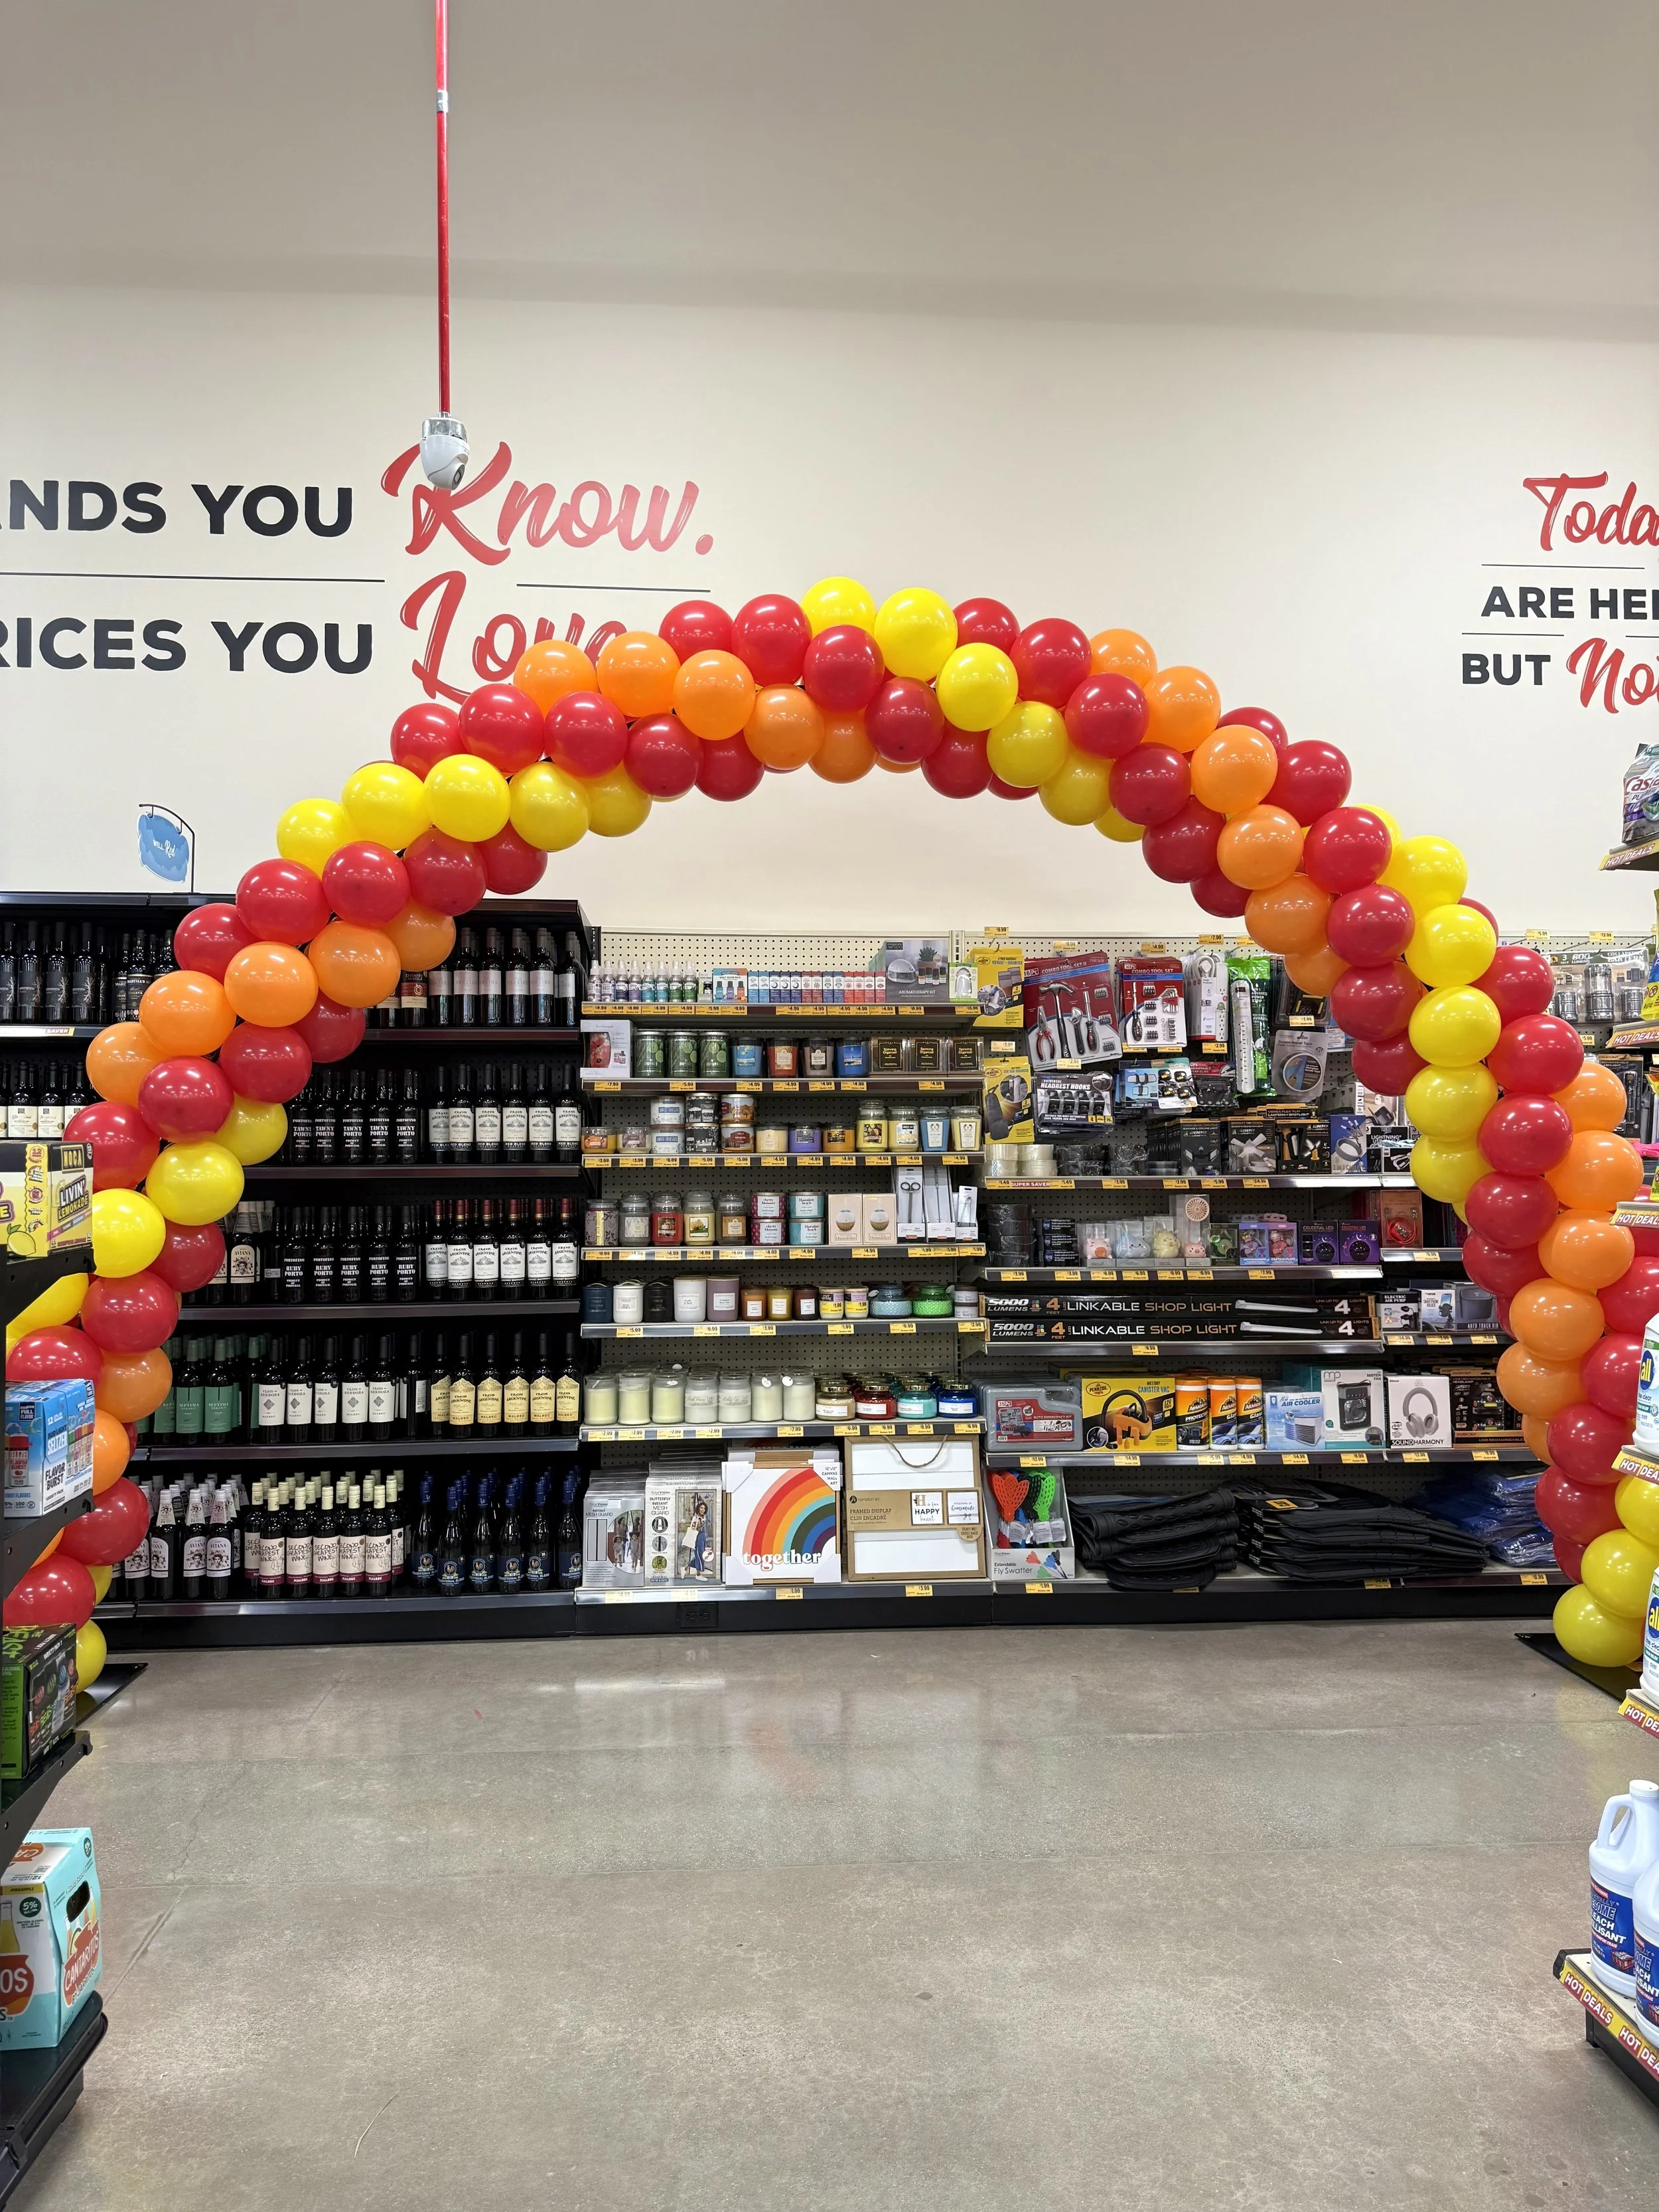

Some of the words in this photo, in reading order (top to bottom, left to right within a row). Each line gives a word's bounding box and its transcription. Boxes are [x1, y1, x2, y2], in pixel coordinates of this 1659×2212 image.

[0, 479, 166, 536] NDS
[191, 483, 354, 538] YOU
[382, 441, 713, 565] Know.
[1481, 586, 1575, 619] ARE
[212, 621, 372, 675] YOU
[1462, 653, 1551, 686] BUT
[1566, 637, 1659, 714] No
[153, 839, 164, 851] WELL
[1605, 855, 1624, 867] HOT
[1624, 844, 1656, 860] DEALS
[1615, 1035, 1630, 1044] HOT
[60, 1179, 85, 1207] LIVIN'
[58, 1194, 89, 1220] LEMONADE
[1617, 1213, 1636, 1223] HOT
[1635, 1215, 1659, 1225] DEAL
[1046, 1297, 1060, 1311] 4
[1067, 1302, 1140, 1311] LINKABLE
[1145, 1303, 1186, 1311] SHOP
[1191, 1303, 1232, 1311] LIGHT
[1334, 1299, 1350, 1315] 4
[1051, 1321, 1066, 1335] 4
[1072, 1326, 1145, 1335] LINKABLE
[1150, 1325, 1192, 1334] SHOP
[1196, 1325, 1237, 1334] LIGHT
[1640, 1358, 1652, 1382] all
[47, 1431, 68, 1455] SELTZER
[48, 1428, 56, 1438] BUD
[45, 1461, 65, 1479] FLAVOR
[1621, 1459, 1640, 1473] HOT
[46, 1473, 64, 1491] BURST
[743, 1549, 822, 1572] together
[1625, 1705, 1646, 1722] HOT
[23, 1901, 38, 1910] 5%
[64, 1929, 100, 1992] CANTARITOS
[1563, 1971, 1585, 1996] HOT
[1583, 1990, 1613, 2025] DEALS
[1619, 2025, 1642, 2053] HOT
